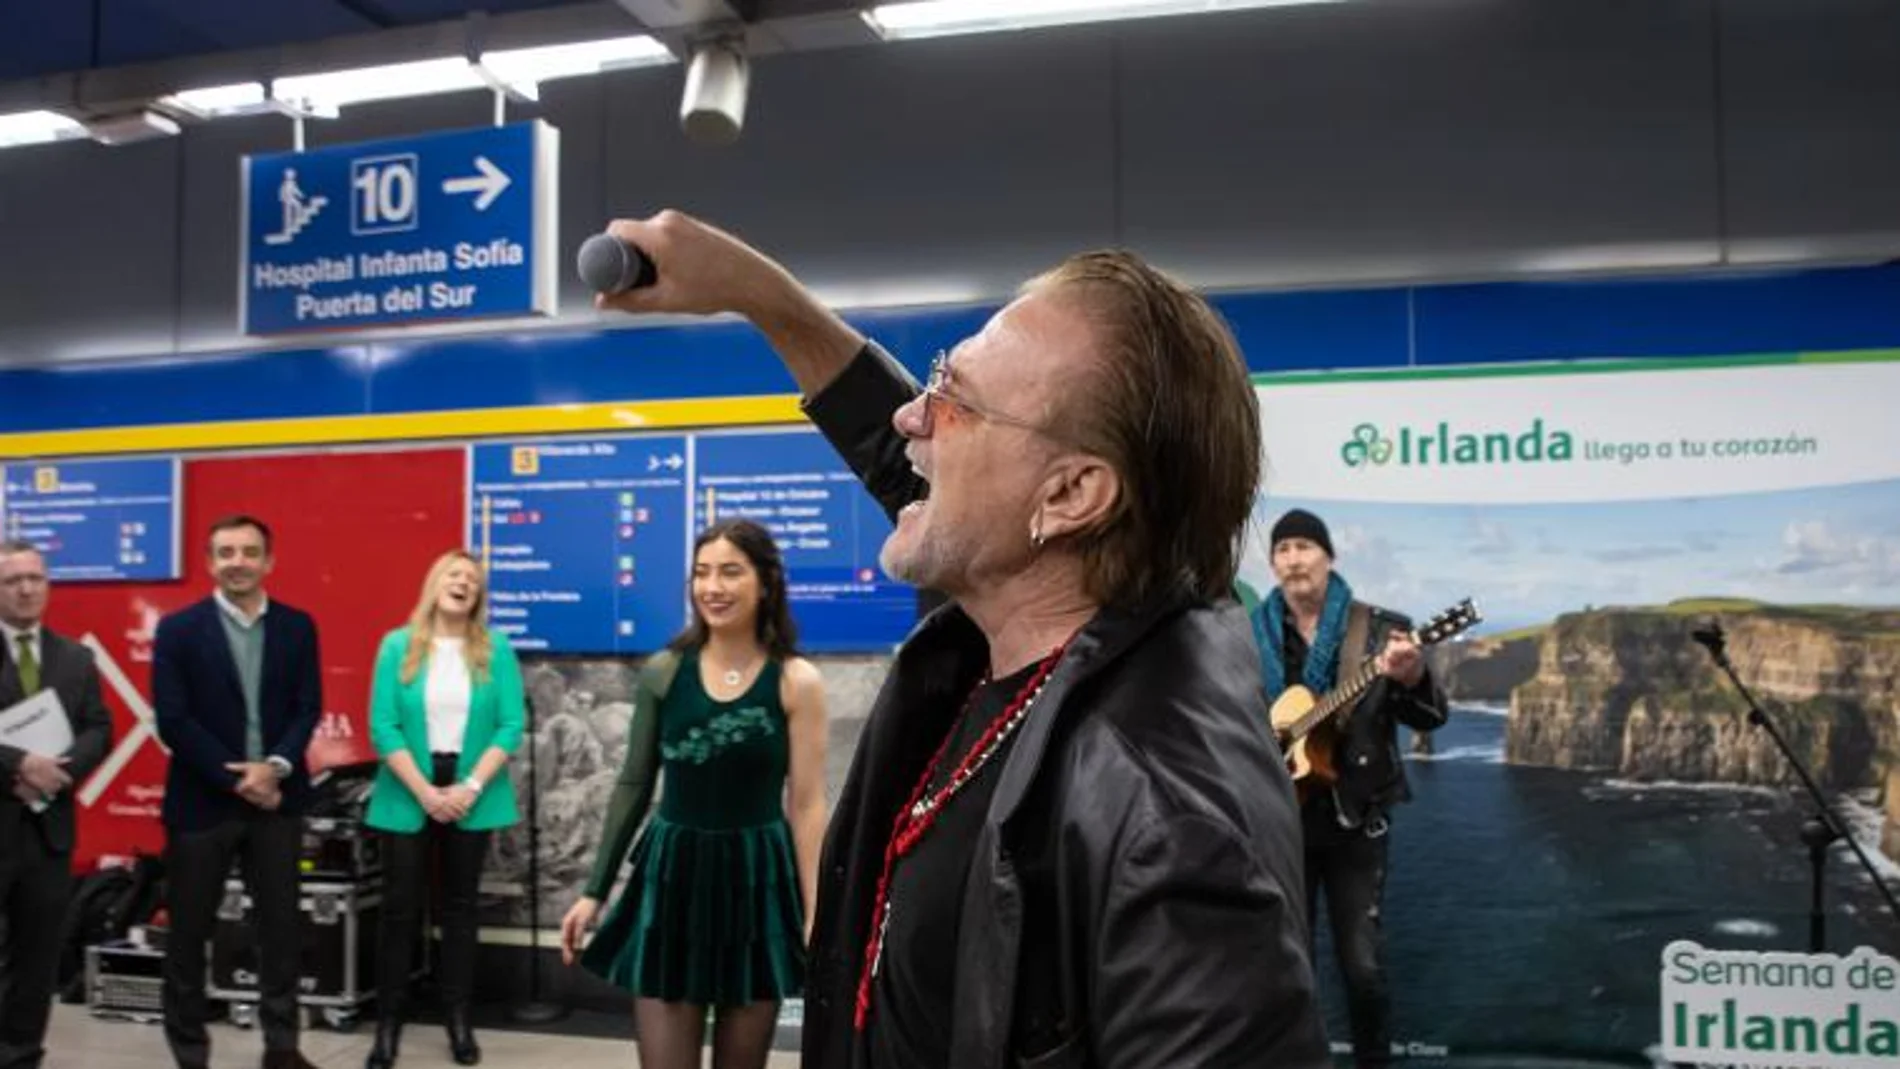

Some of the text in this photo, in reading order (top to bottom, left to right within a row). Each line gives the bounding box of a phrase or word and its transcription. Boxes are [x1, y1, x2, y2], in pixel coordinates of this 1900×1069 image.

[354, 163, 414, 223] 10
[254, 238, 523, 290] Hospital Infanta Sofía
[296, 282, 476, 320] Puerta del Sur
[1400, 418, 1573, 465] Irlanda
[1656, 441, 1673, 459] a
[1681, 438, 1706, 458] tu
[1711, 431, 1818, 457] corazón
[1672, 952, 1896, 991] Semana de
[1674, 998, 1899, 1057] Irlanda
